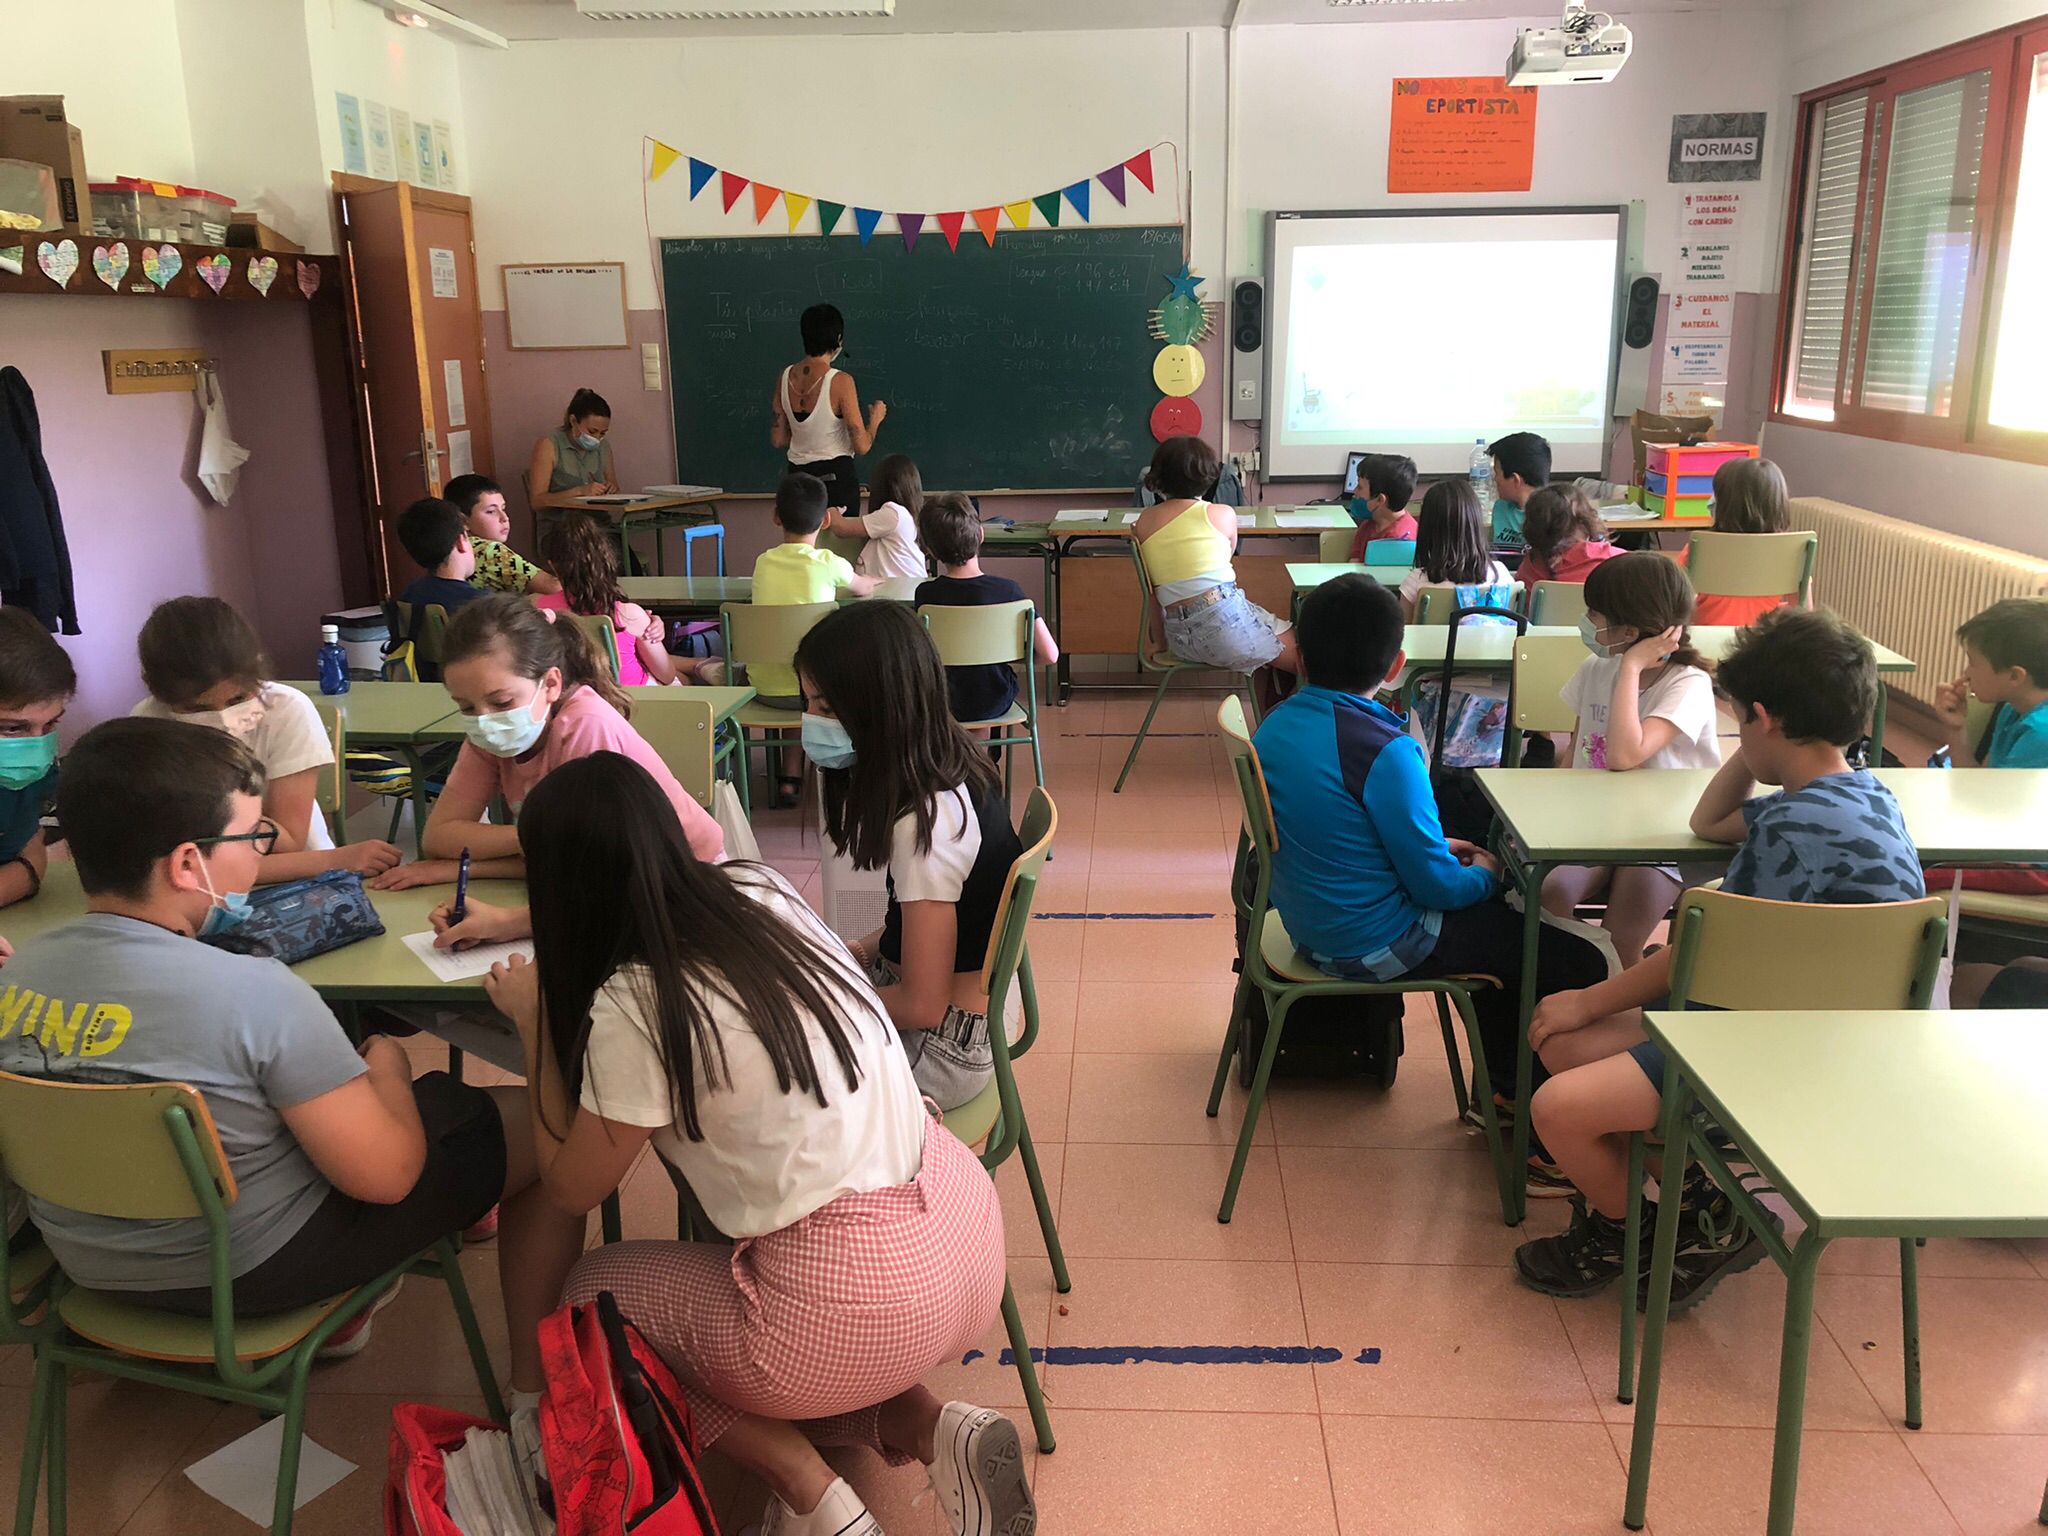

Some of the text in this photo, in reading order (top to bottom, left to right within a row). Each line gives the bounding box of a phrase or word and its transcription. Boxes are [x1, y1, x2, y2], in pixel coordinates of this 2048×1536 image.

[1685, 142, 1754, 157] NORMAS
[1688, 295, 1729, 303] CUIDAMOS
[1702, 308, 1712, 316] EL
[1681, 321, 1719, 329] MATERIAL
